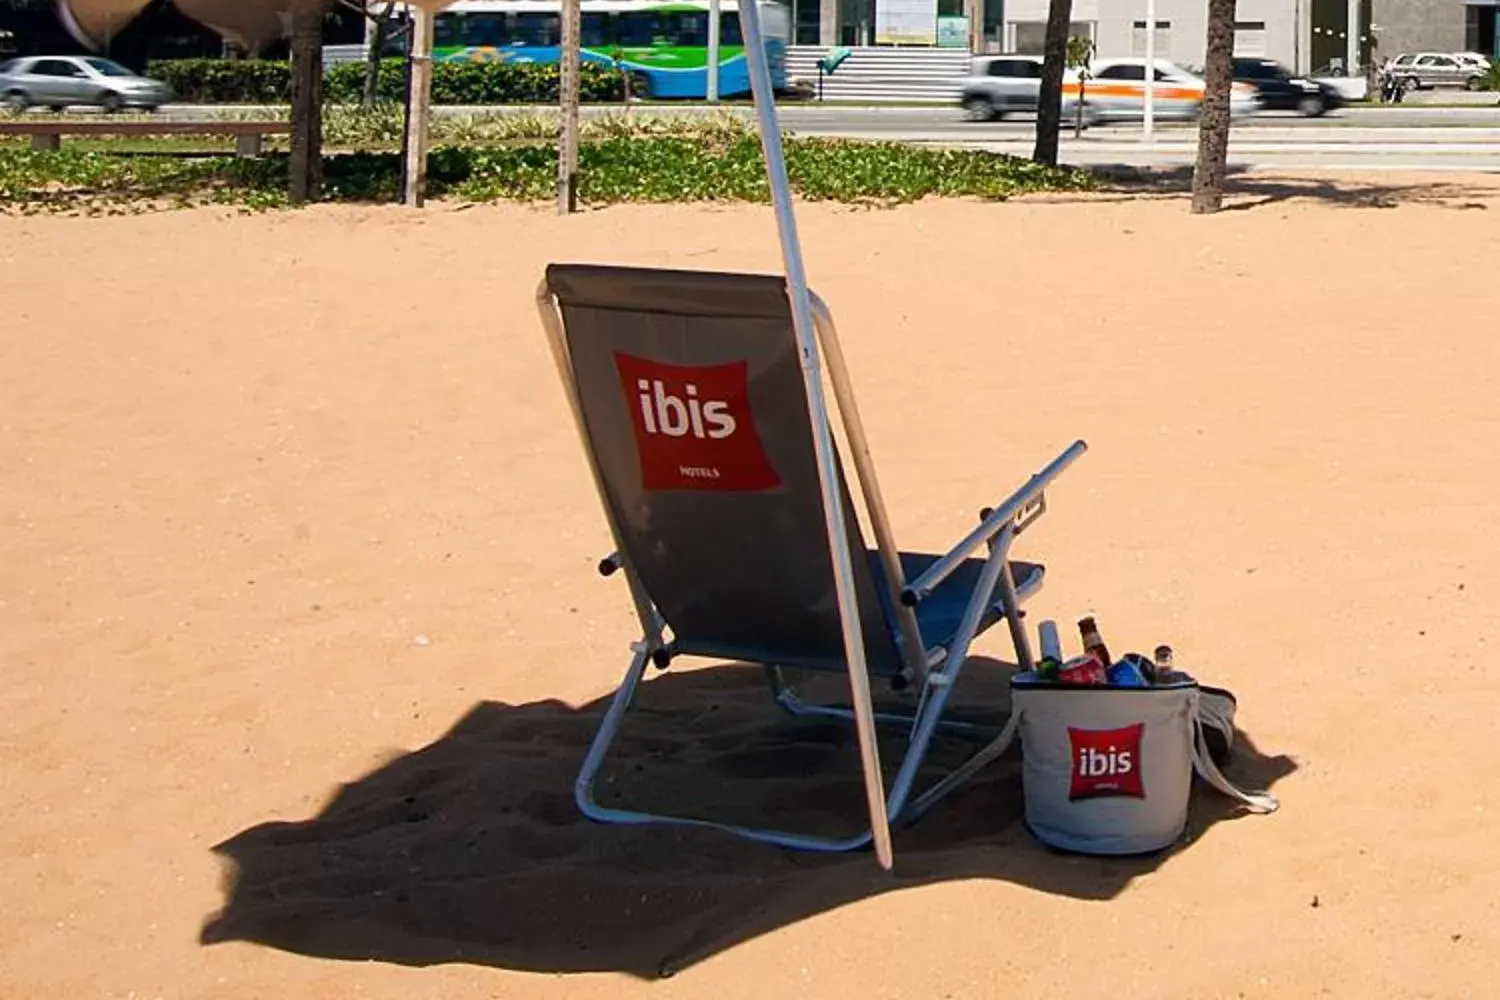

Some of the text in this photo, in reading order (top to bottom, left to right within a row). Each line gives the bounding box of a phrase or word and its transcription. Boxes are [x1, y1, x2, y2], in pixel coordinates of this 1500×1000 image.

[637, 379, 737, 439] ibis
[679, 466, 721, 478] HOTELS
[1080, 745, 1132, 776] ibis
